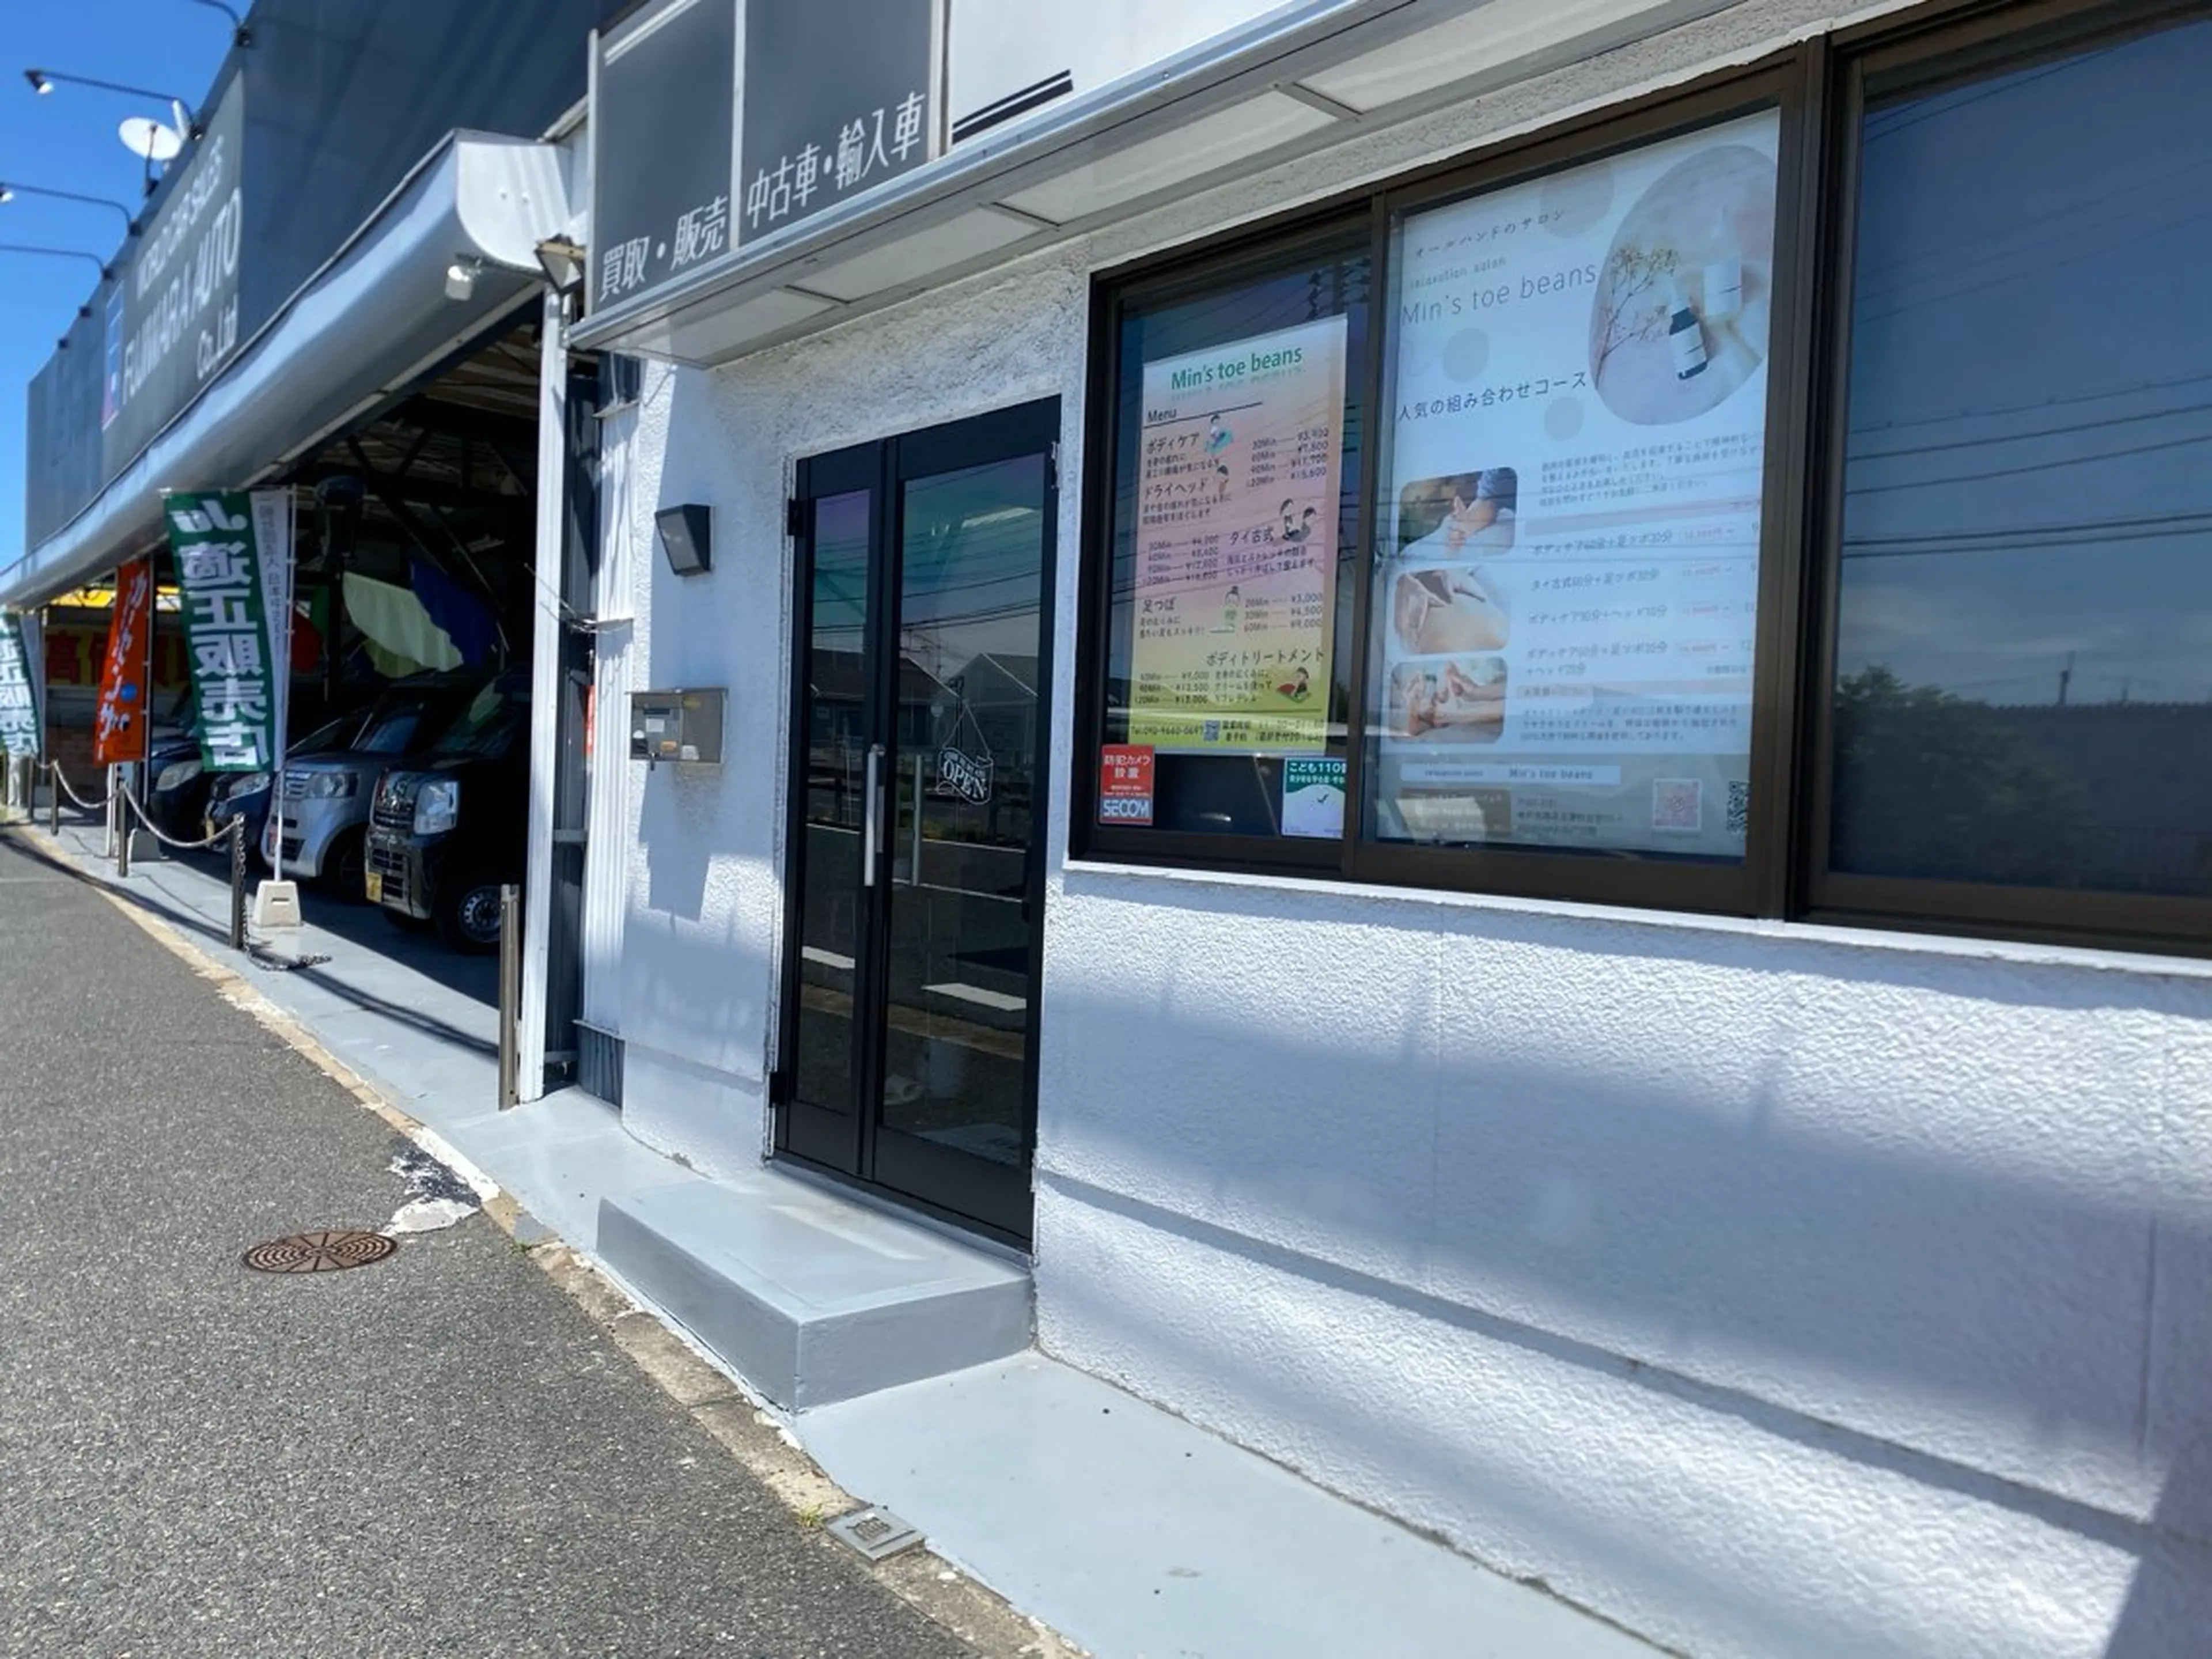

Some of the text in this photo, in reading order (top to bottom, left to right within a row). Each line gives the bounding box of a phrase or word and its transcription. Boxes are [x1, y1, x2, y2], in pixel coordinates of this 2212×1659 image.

[747, 92, 925, 229] 中古車・輸入車
[190, 188, 241, 321] AUTO
[600, 195, 728, 302] 買取・販売
[1402, 264, 1596, 326] Min's toe beans
[1171, 347, 1302, 391] Min's toe beans
[1147, 408, 1177, 422] Menu
[1398, 372, 1586, 422] 人気の組み合わせコース
[1146, 432, 1200, 454] ボディケア
[1229, 527, 1274, 546] タイ古式
[1143, 596, 1177, 614] 足つぼ
[1206, 647, 1324, 666] ボディトリートメント
[942, 759, 988, 799] OPEN
[1103, 798, 1150, 818] SECOM
